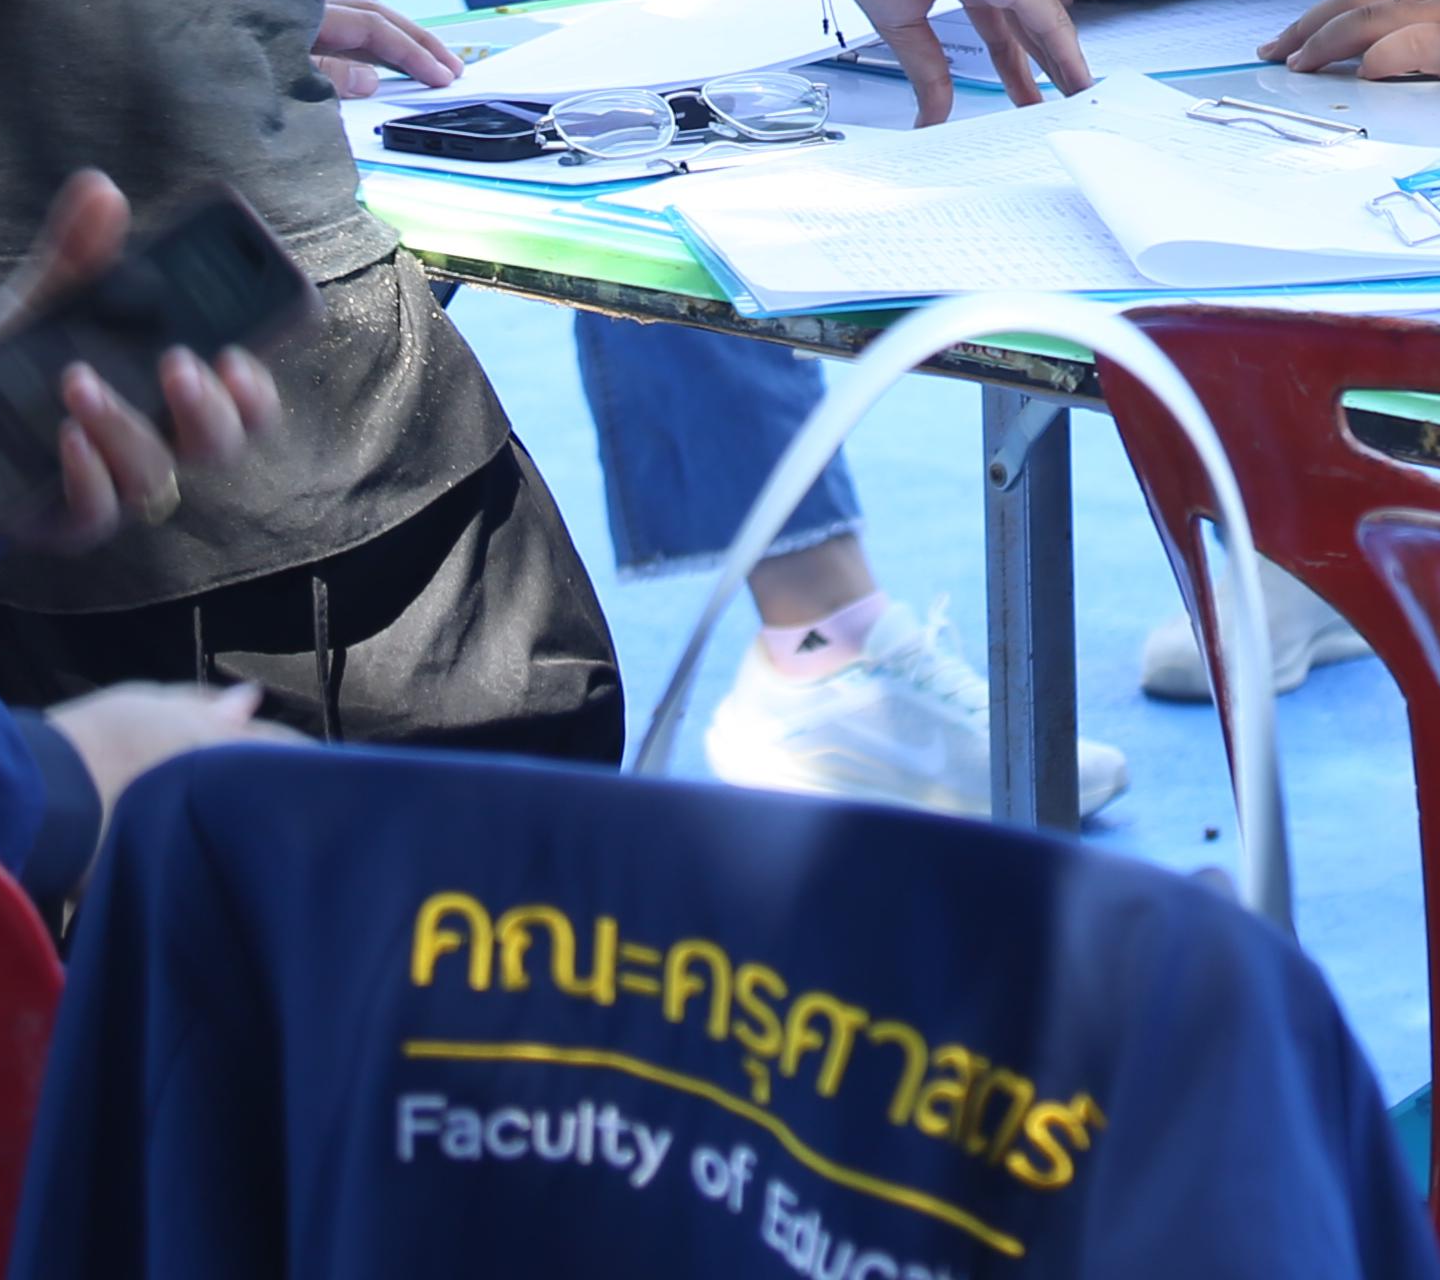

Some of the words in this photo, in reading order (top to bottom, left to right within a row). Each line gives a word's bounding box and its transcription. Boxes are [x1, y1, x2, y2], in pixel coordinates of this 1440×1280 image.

[410, 890, 1108, 1190] คณะครุศาสตร์
[396, 1093, 674, 1189] Faculty
[690, 1144, 758, 1214] of
